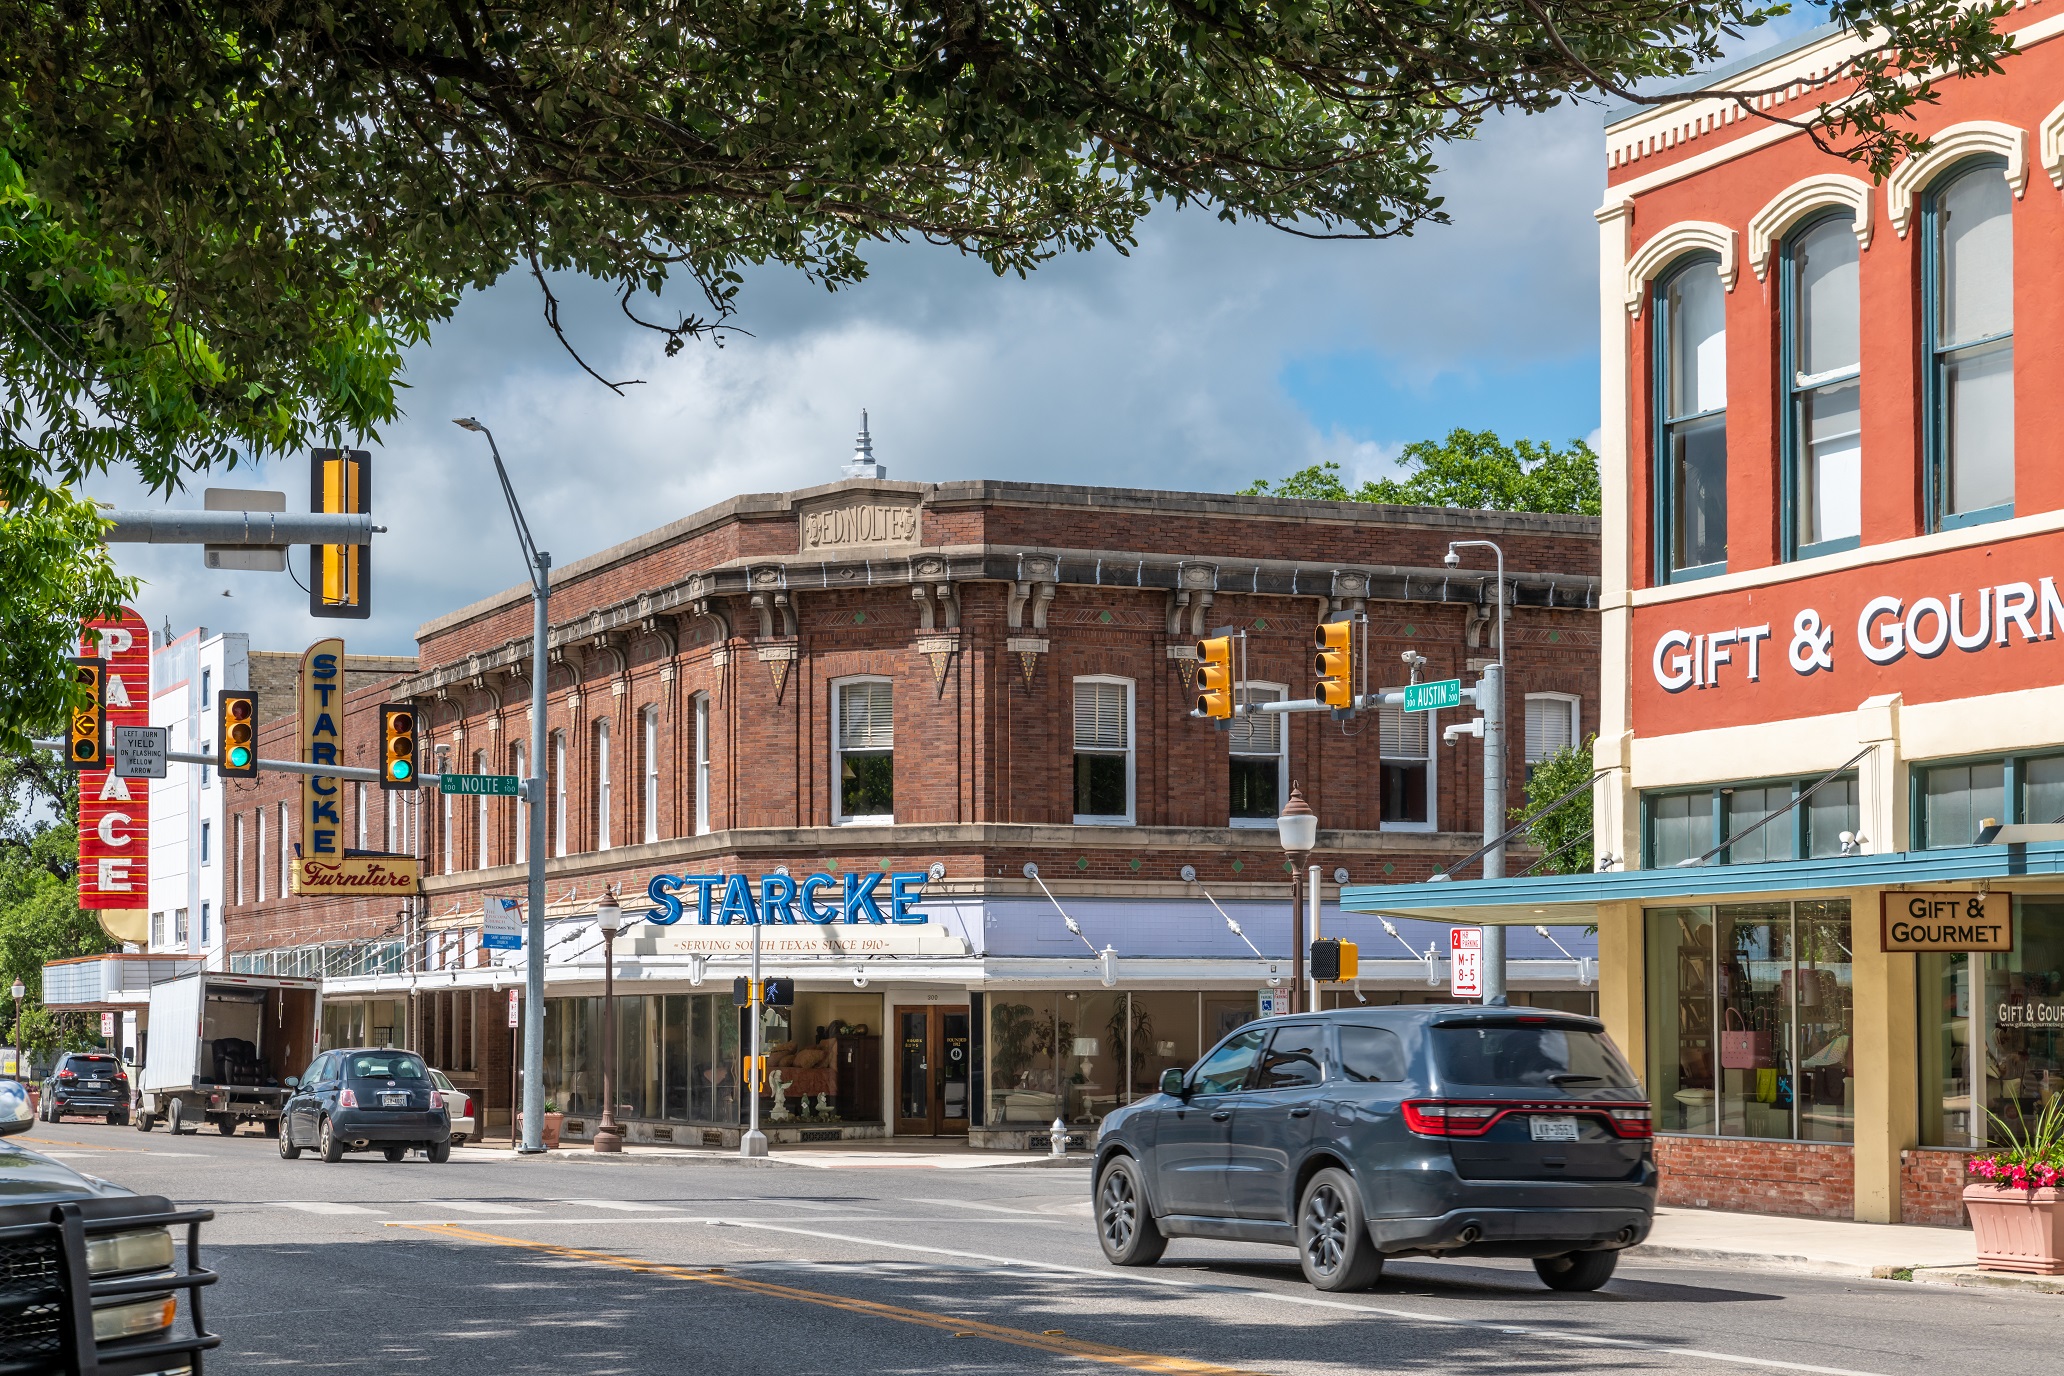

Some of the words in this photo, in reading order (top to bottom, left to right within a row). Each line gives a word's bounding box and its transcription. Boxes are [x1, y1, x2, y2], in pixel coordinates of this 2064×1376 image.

[1653, 622, 1771, 694] GIFT
[1788, 608, 1834, 676] &
[1406, 699, 1416, 708] 300
[1448, 693, 1457, 702] 200
[1417, 685, 1447, 707] AUSTIN
[1450, 683, 1456, 692] ST
[128, 739, 154, 748] YIELD
[311, 654, 339, 853] STARCKE
[98, 628, 133, 892] PAACE
[461, 777, 499, 793] NOLTE
[301, 861, 412, 887] Furniture
[646, 872, 930, 926] STARCKE
[1908, 897, 1961, 919] GIFT
[1966, 897, 1985, 919] &
[1453, 932, 1459, 946] 2
[1891, 921, 2002, 943] GOURMET
[681, 940, 731, 951] SERVING
[780, 940, 818, 951] TEXAS
[822, 940, 858, 951] SINCE
[861, 940, 884, 951] 1910
[1461, 939, 1479, 948] PARKING
[1999, 1003, 2023, 1022] GIFT
[2026, 1003, 2034, 1022] &
